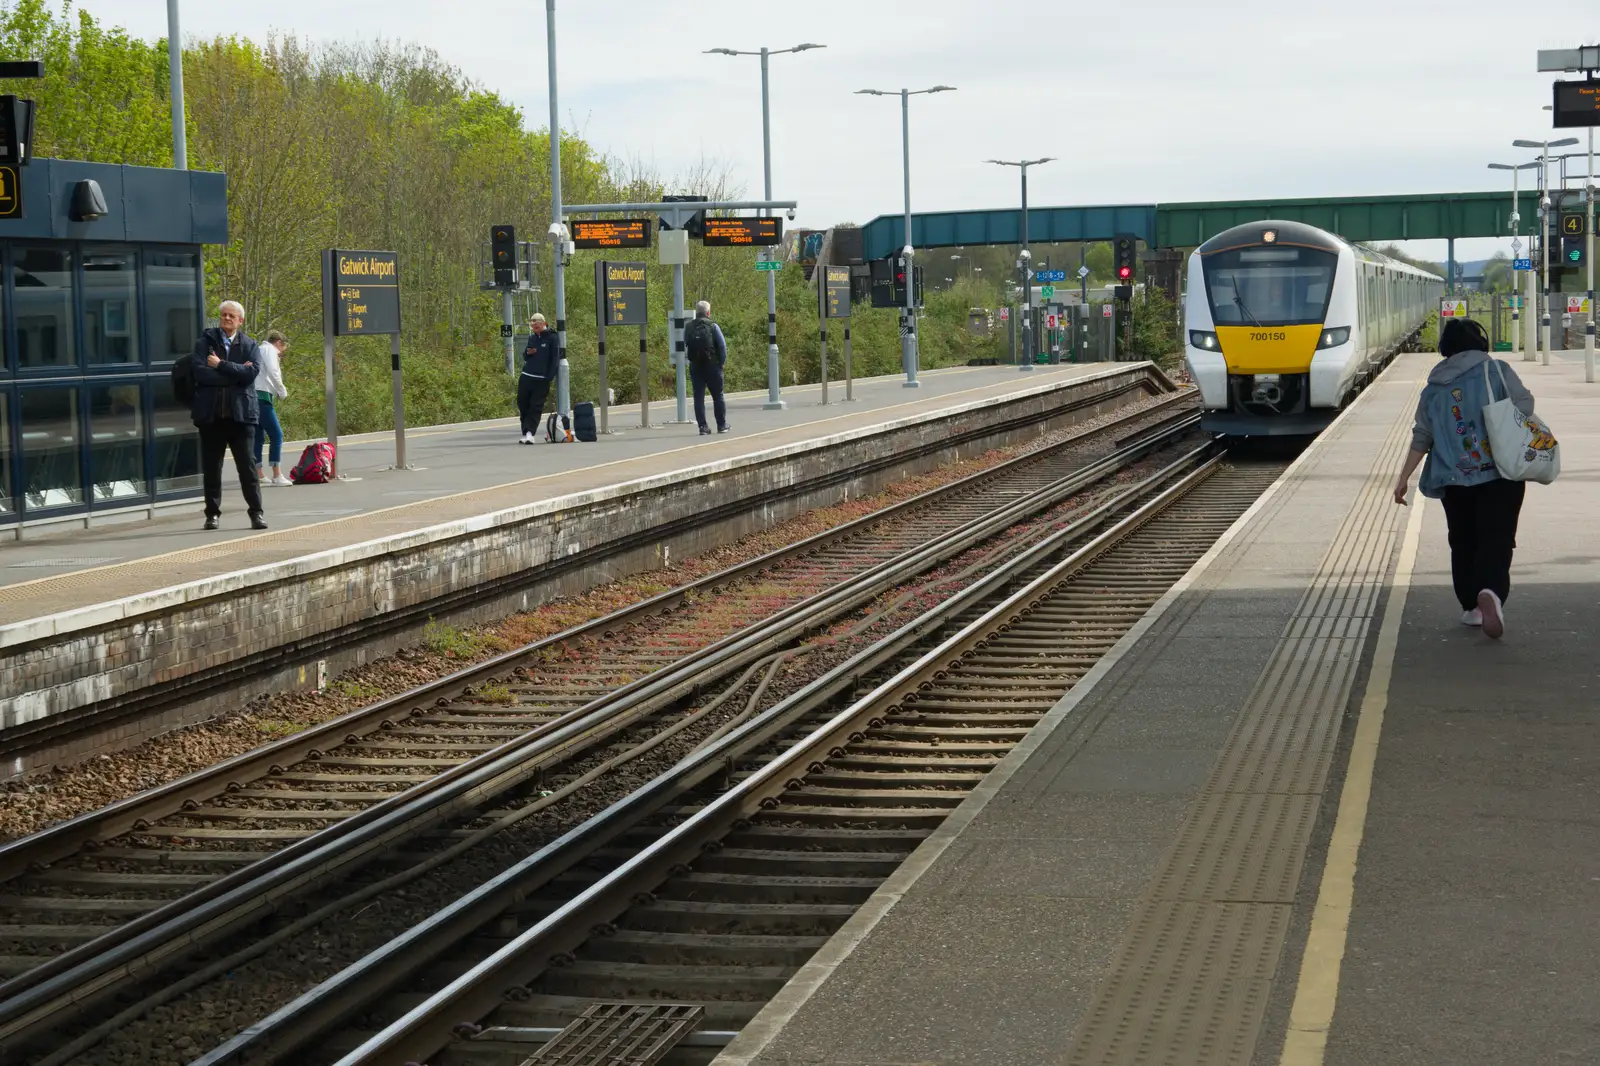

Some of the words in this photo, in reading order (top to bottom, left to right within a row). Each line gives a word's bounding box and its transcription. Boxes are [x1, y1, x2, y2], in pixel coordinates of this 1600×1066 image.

[1568, 219, 1577, 230] 4
[340, 257, 369, 275] Gatwick
[370, 258, 395, 279] Airport
[608, 266, 627, 280] Gatwick
[628, 267, 644, 284] Airport
[353, 304, 367, 315] Airport
[353, 318, 362, 328] Lifts
[1250, 332, 1285, 340] 700150
